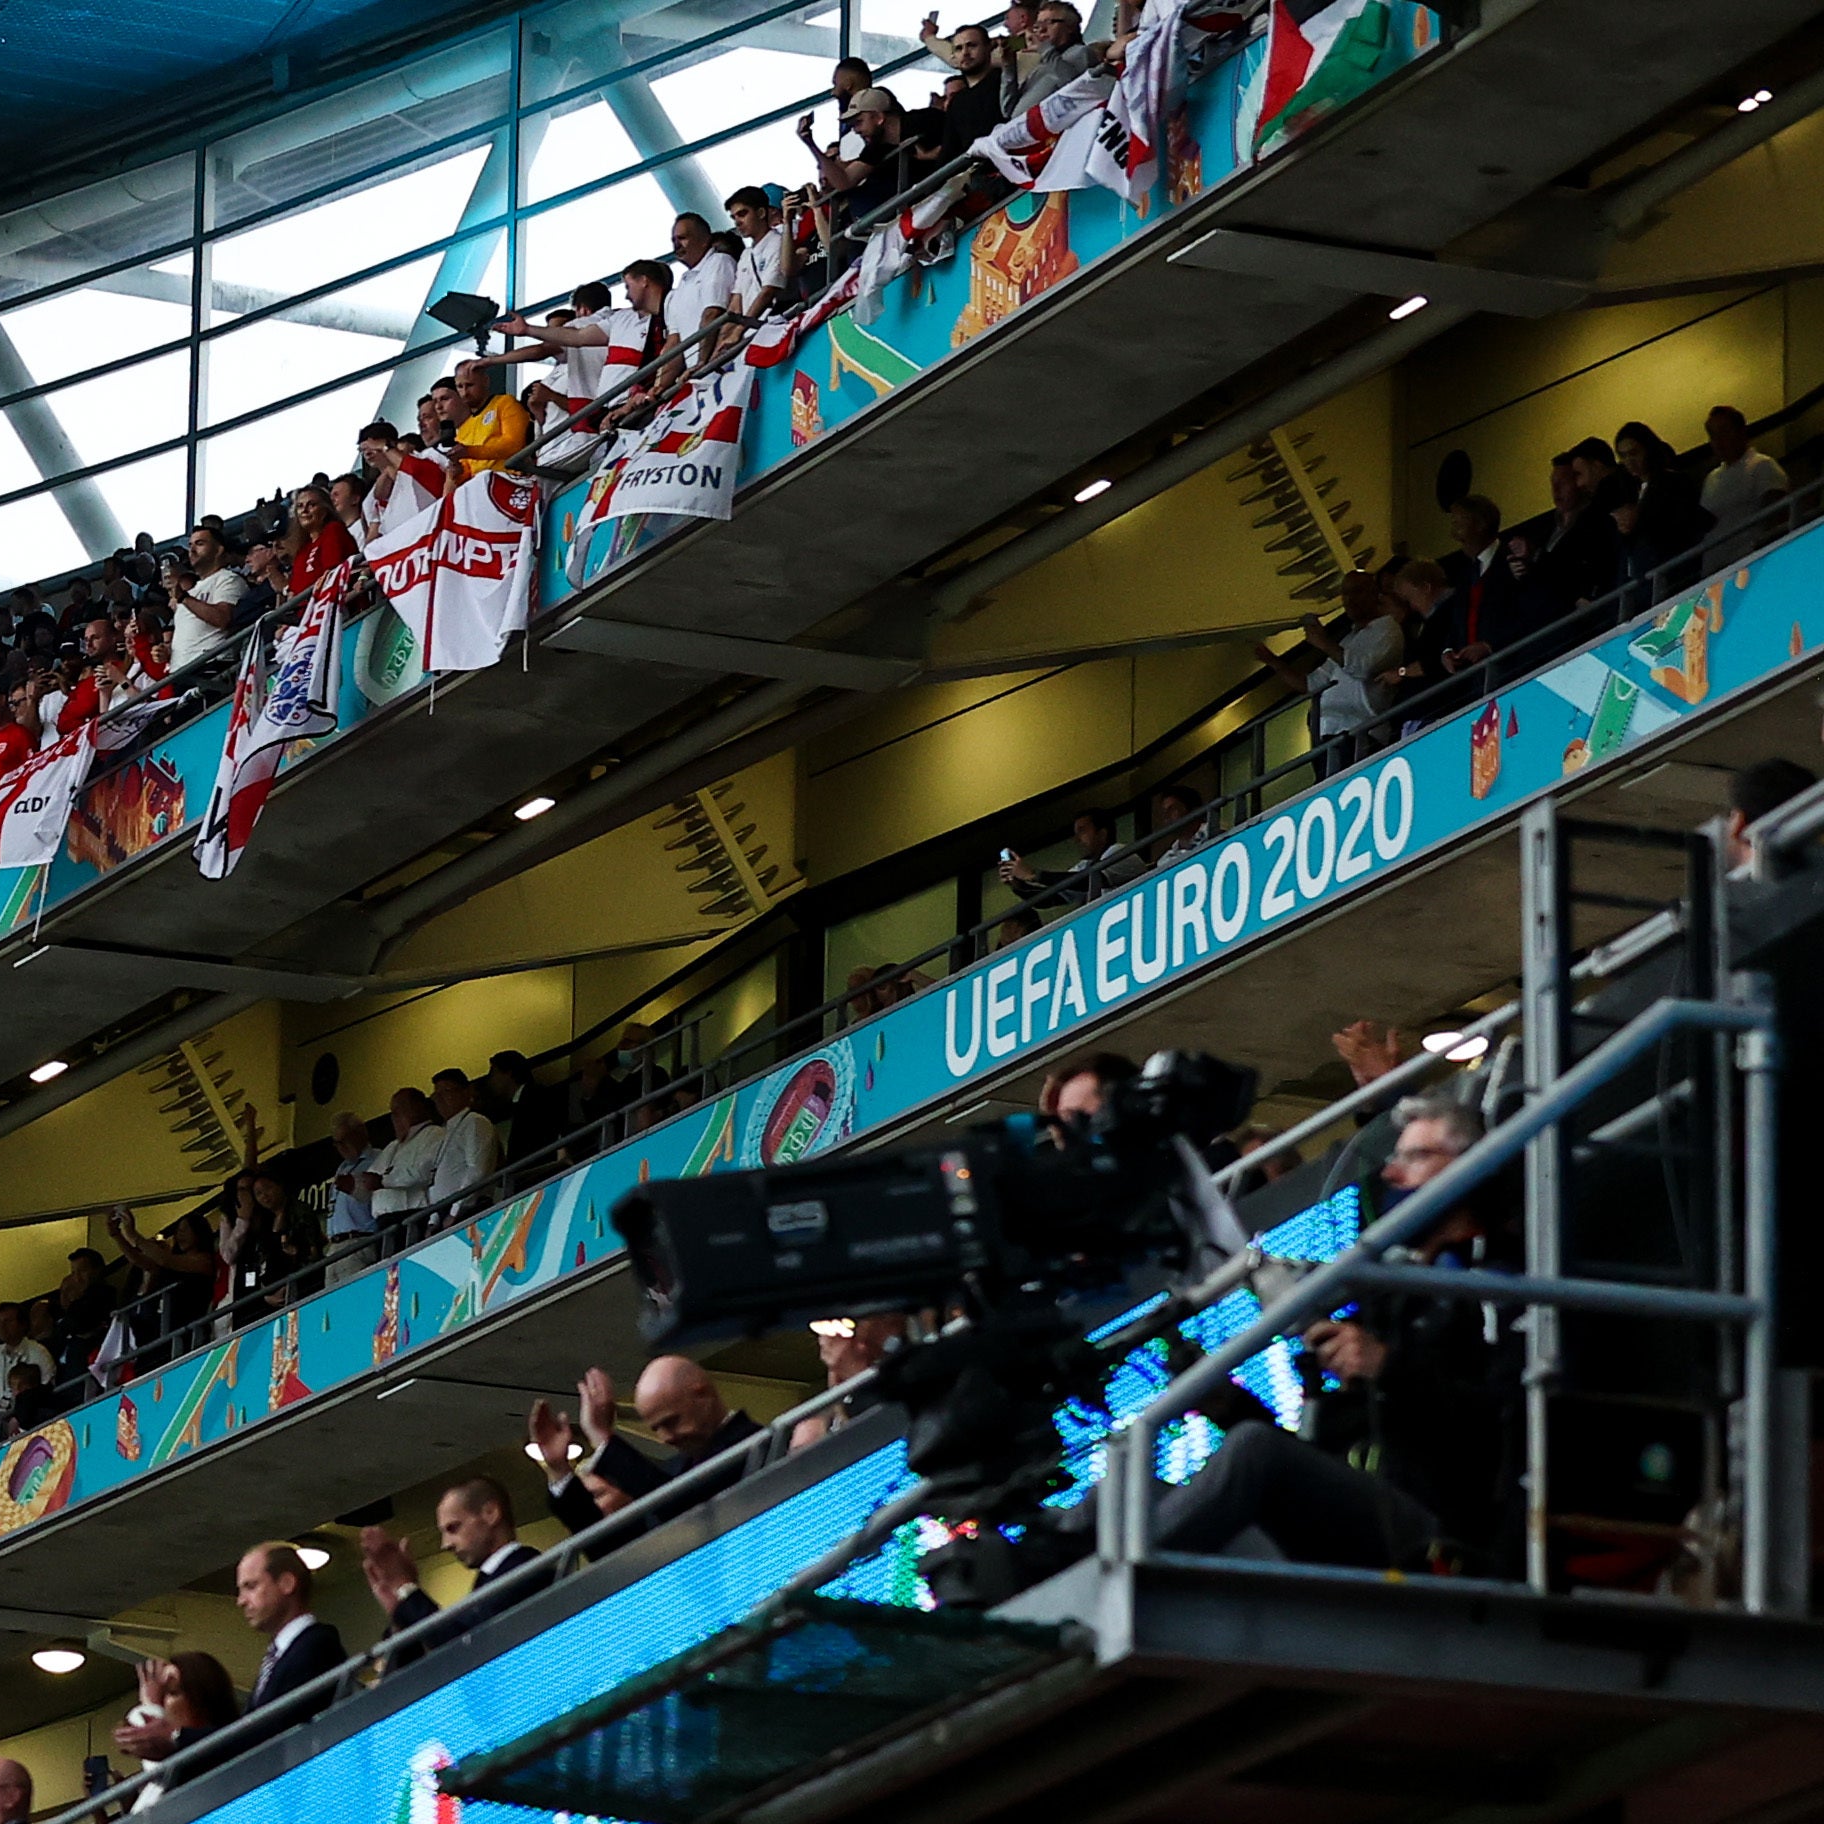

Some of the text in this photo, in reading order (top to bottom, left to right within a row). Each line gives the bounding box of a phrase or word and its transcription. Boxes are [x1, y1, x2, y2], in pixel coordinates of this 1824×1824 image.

[620, 464, 721, 490] FRYSTON
[946, 757, 1413, 1077] UEFA EURO 2020
